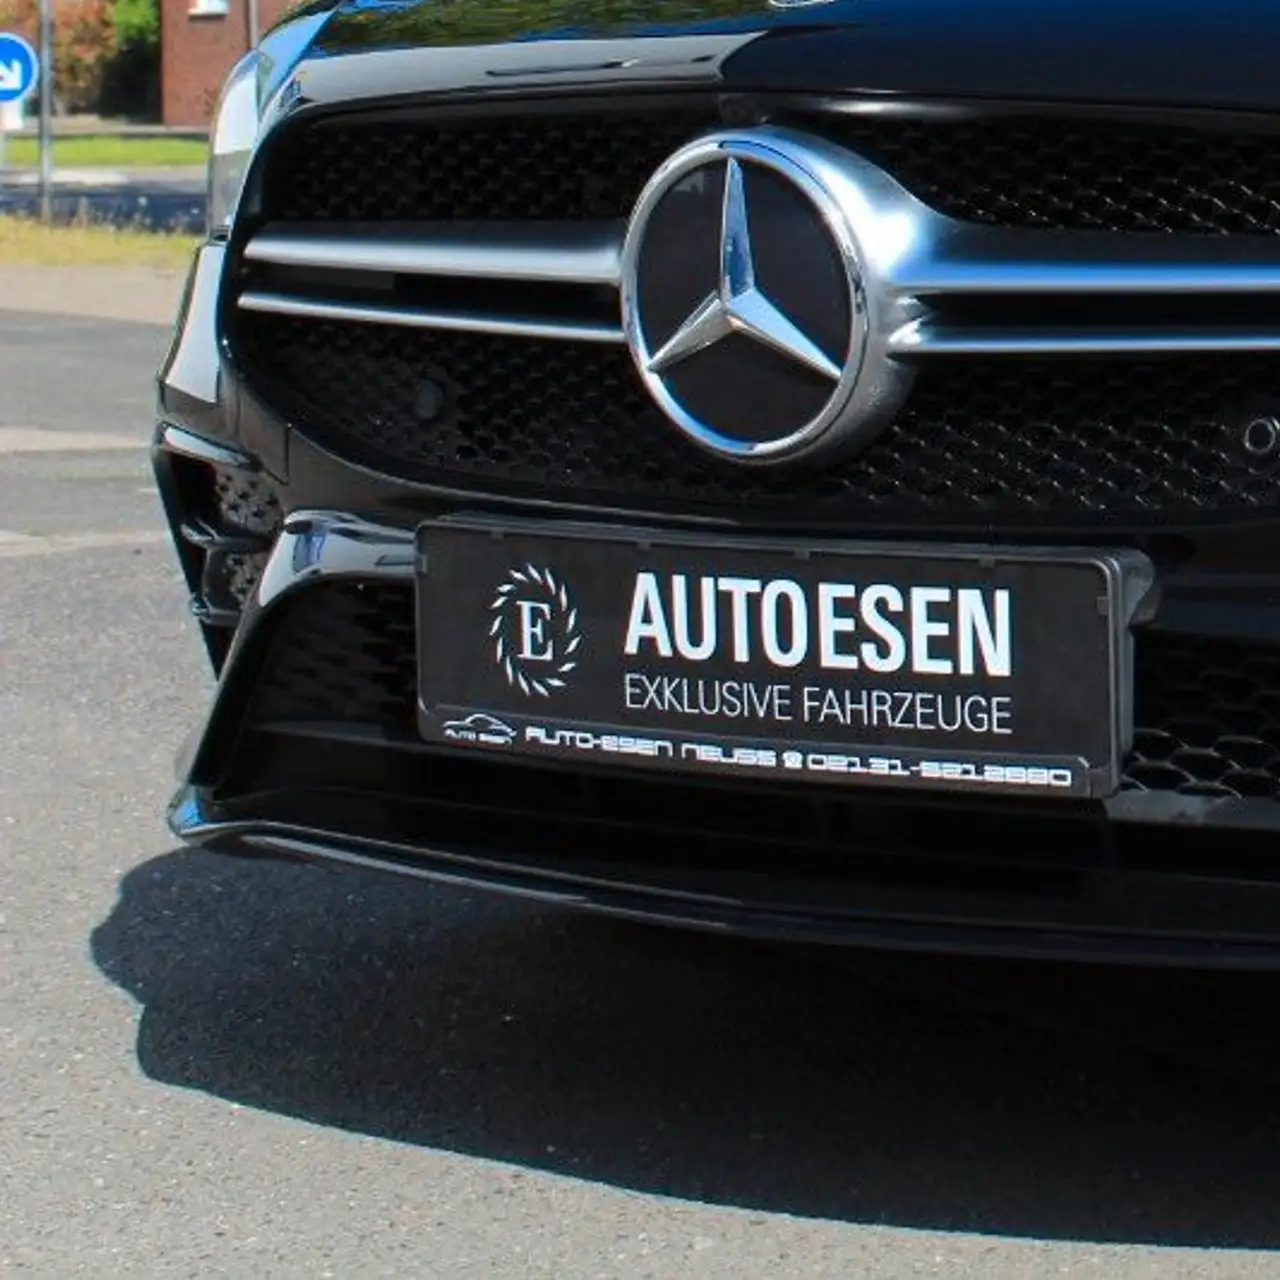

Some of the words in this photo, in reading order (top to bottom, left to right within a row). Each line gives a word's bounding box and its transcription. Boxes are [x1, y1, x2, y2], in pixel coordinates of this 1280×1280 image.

[516, 601, 553, 662] E
[624, 673, 793, 721] EXKLUSIVE
[803, 686, 1013, 735] FAHRZEUGE
